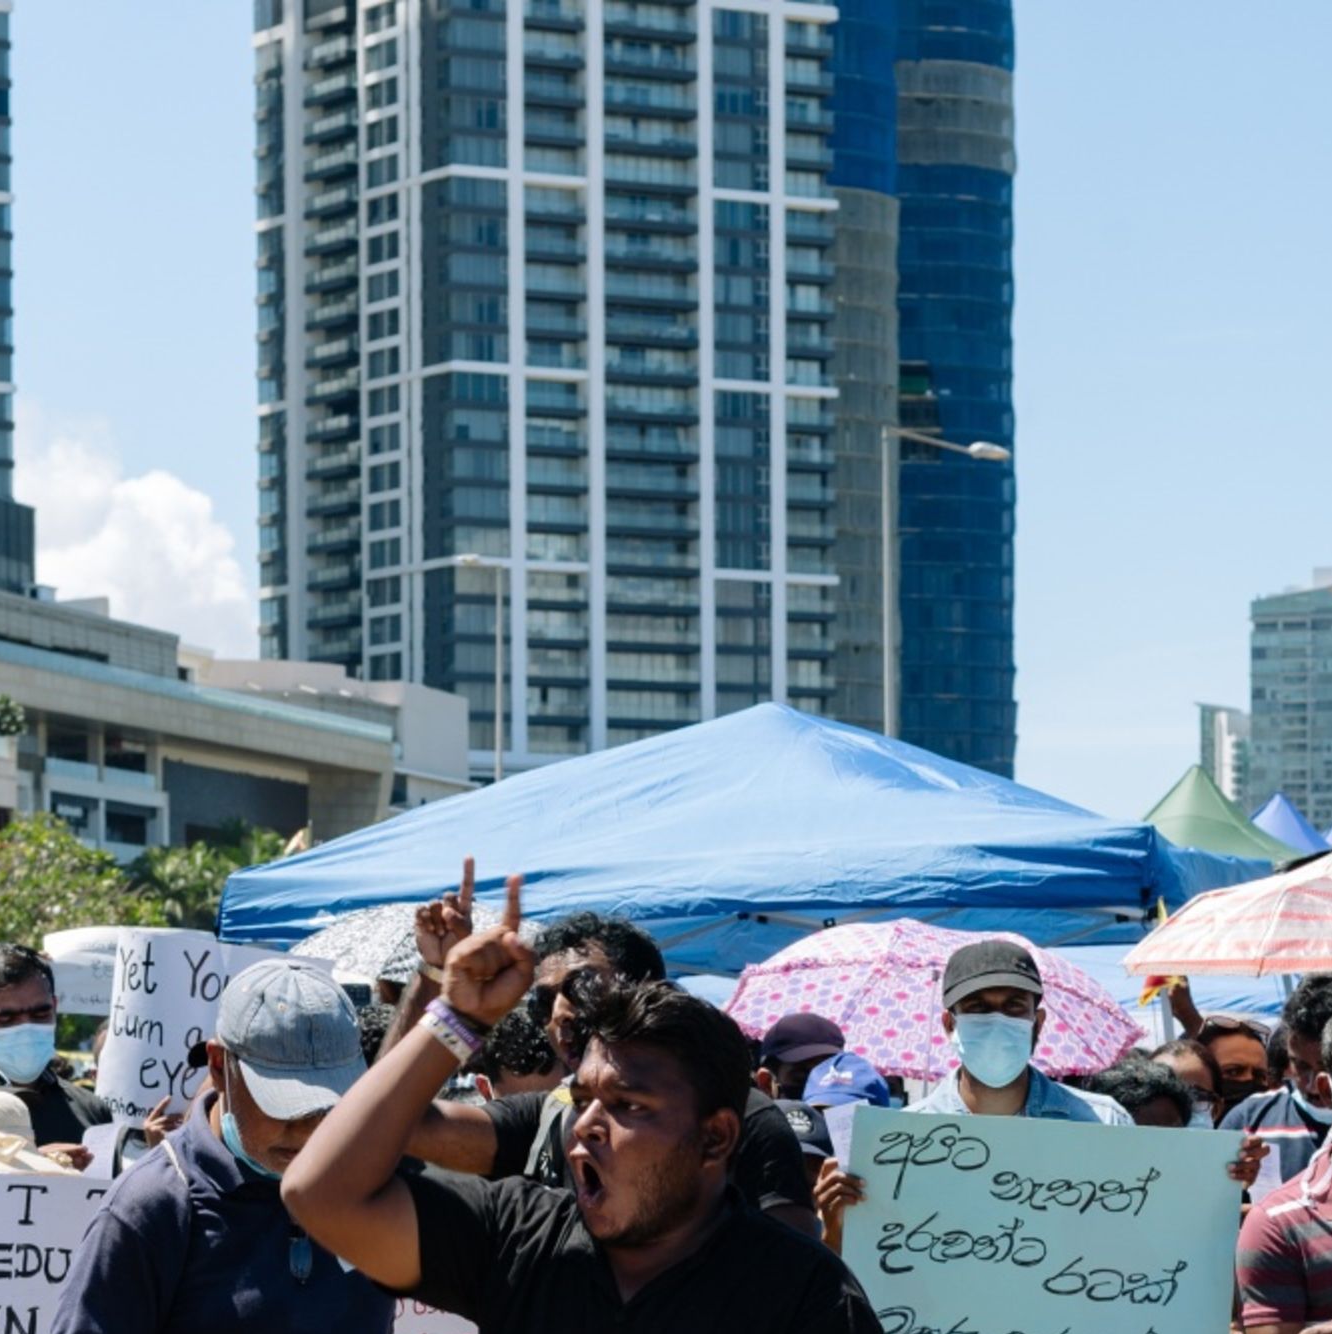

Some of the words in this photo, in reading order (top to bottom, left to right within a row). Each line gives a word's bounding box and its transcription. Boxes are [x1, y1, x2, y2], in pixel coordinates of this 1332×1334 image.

[119, 942, 157, 994] Yet
[183, 950, 230, 1002] Yo
[113, 998, 164, 1047] turn
